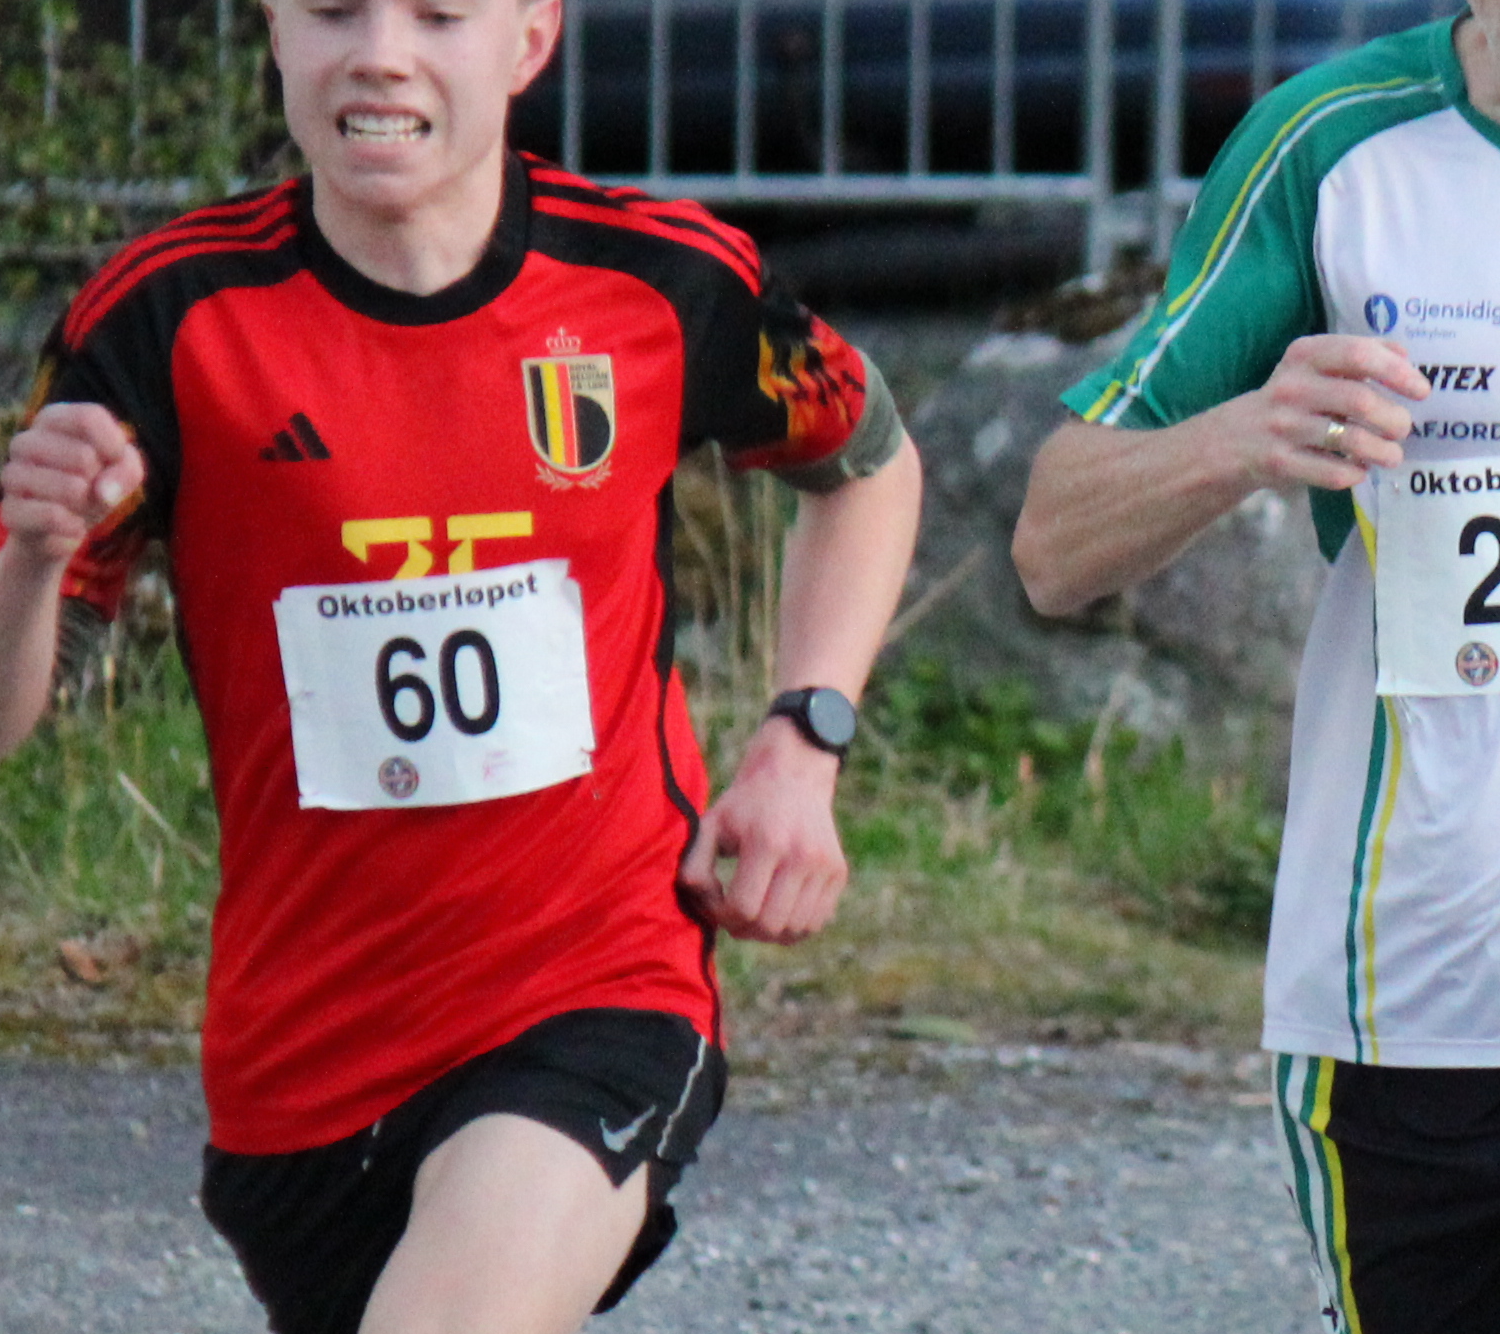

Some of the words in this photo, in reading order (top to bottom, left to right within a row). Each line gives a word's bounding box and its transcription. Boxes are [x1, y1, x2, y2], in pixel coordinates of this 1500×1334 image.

[1416, 365, 1497, 392] MTEX
[316, 570, 539, 619] Oktoberløpet
[374, 628, 501, 743] 60
